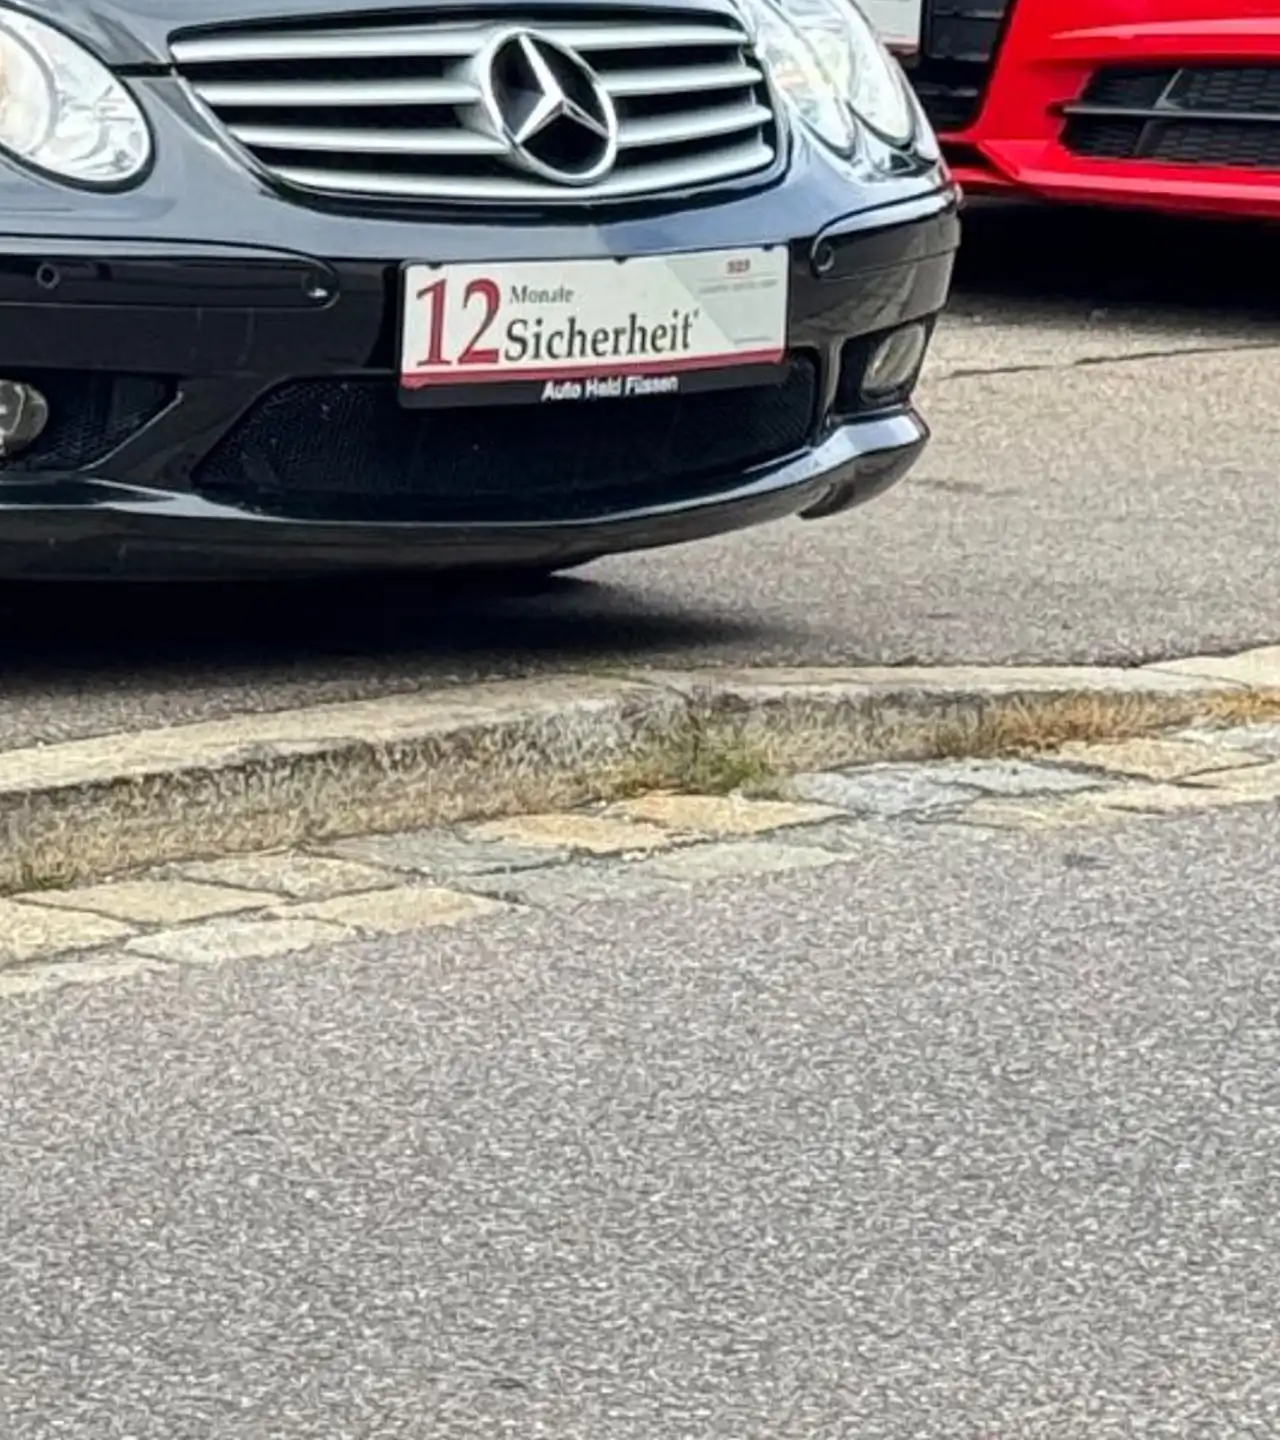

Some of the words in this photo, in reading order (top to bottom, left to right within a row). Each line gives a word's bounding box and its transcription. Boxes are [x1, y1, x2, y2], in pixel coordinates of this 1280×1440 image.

[510, 284, 574, 303] Monate
[416, 277, 500, 366] 12
[541, 381, 582, 402] Auto
